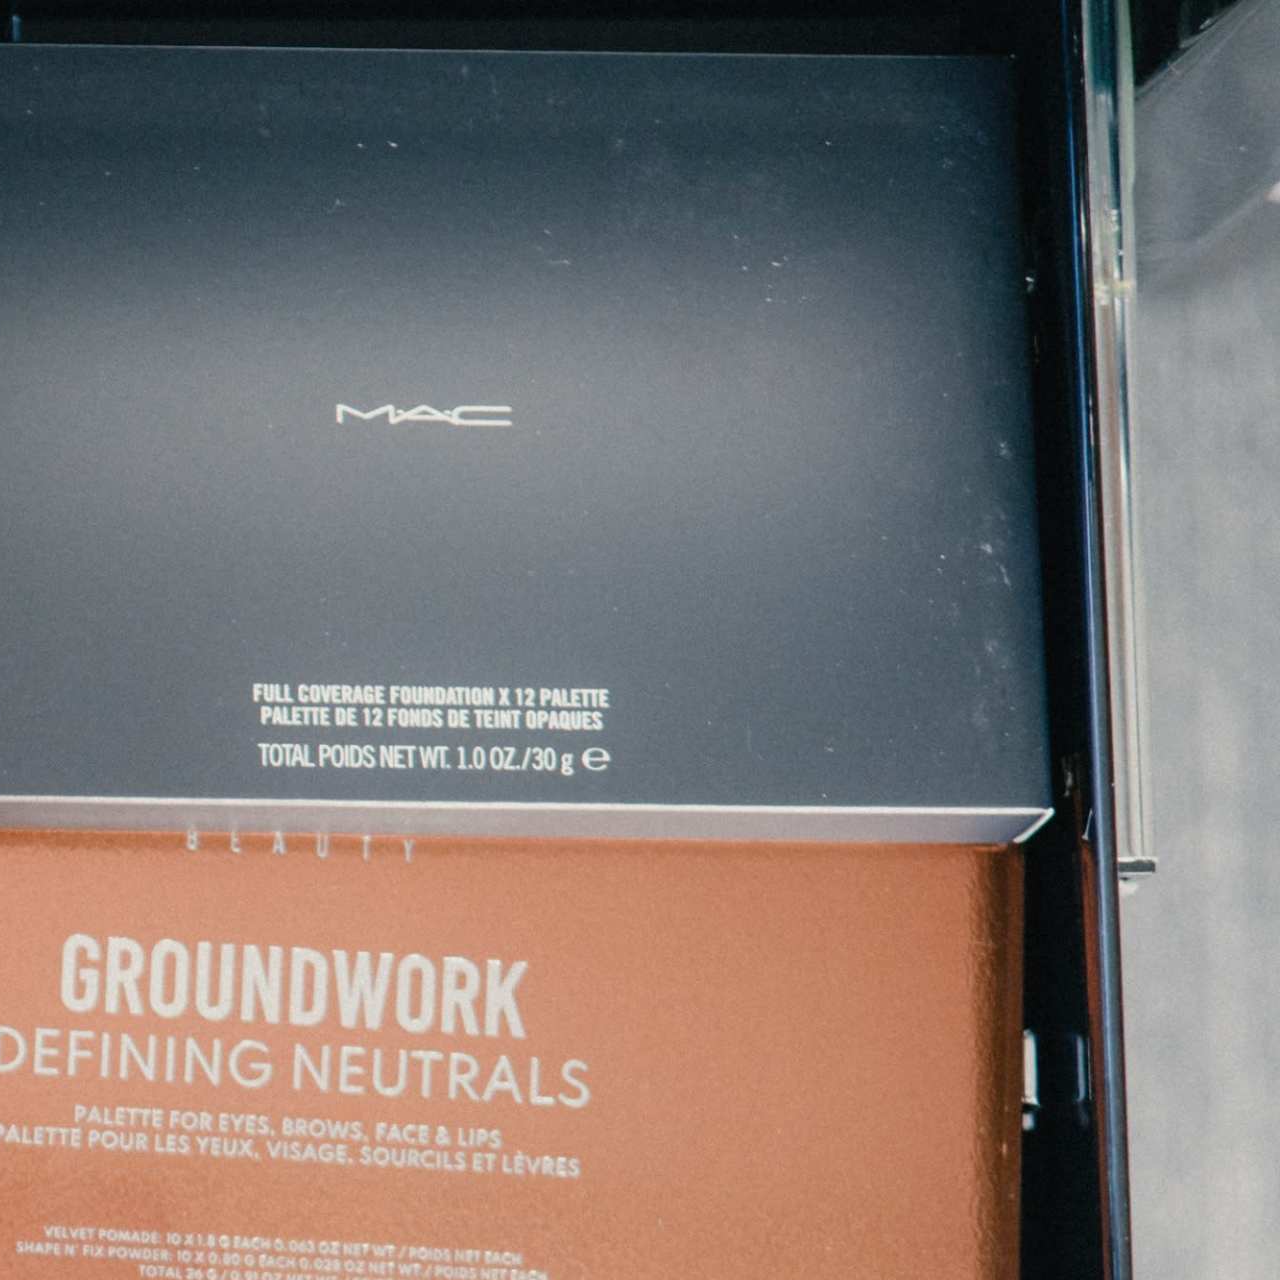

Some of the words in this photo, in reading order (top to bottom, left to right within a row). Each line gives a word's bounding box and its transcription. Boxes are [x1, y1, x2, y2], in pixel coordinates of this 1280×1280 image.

[252, 682, 294, 703] FULL
[297, 683, 386, 705] COVERAGE
[389, 685, 495, 706] FOUNDATION
[498, 686, 511, 706] X
[514, 686, 535, 707] 12
[539, 687, 611, 709] PALETTE
[259, 705, 332, 727] PALETTE
[334, 706, 359, 727] DE
[362, 706, 384, 728] 12
[387, 707, 444, 729] FONDS
[446, 708, 471, 729] DE
[474, 709, 522, 730] TEINT
[525, 710, 604, 732] OPAQUES
[257, 742, 316, 768] TOTAL
[317, 743, 377, 769] POIDS
[378, 744, 418, 769] NET
[418, 744, 453, 770] WT.
[456, 745, 486, 771] 1.0
[559, 751, 576, 777] g
[59, 932, 529, 1039] GROUNDWORK
[291, 1042, 592, 1110] NEUTRALS
[73, 1103, 164, 1129] PALETTE
[168, 1109, 214, 1133] FOR
[373, 1121, 429, 1146] FACE
[435, 1124, 452, 1146] &
[457, 1127, 503, 1150] LIPS
[87, 1129, 149, 1152] POUR
[153, 1133, 191, 1154] LES
[358, 1144, 467, 1172] SOURCILS
[471, 1151, 498, 1174] ET
[501, 1151, 582, 1178] LÈVRES
[15, 1240, 62, 1257] SHAPE
[81, 1244, 105, 1260] FIX
[43, 1225, 98, 1241] VELVET
[233, 1235, 273, 1252] EACH
[137, 1264, 183, 1280] TOTAL
